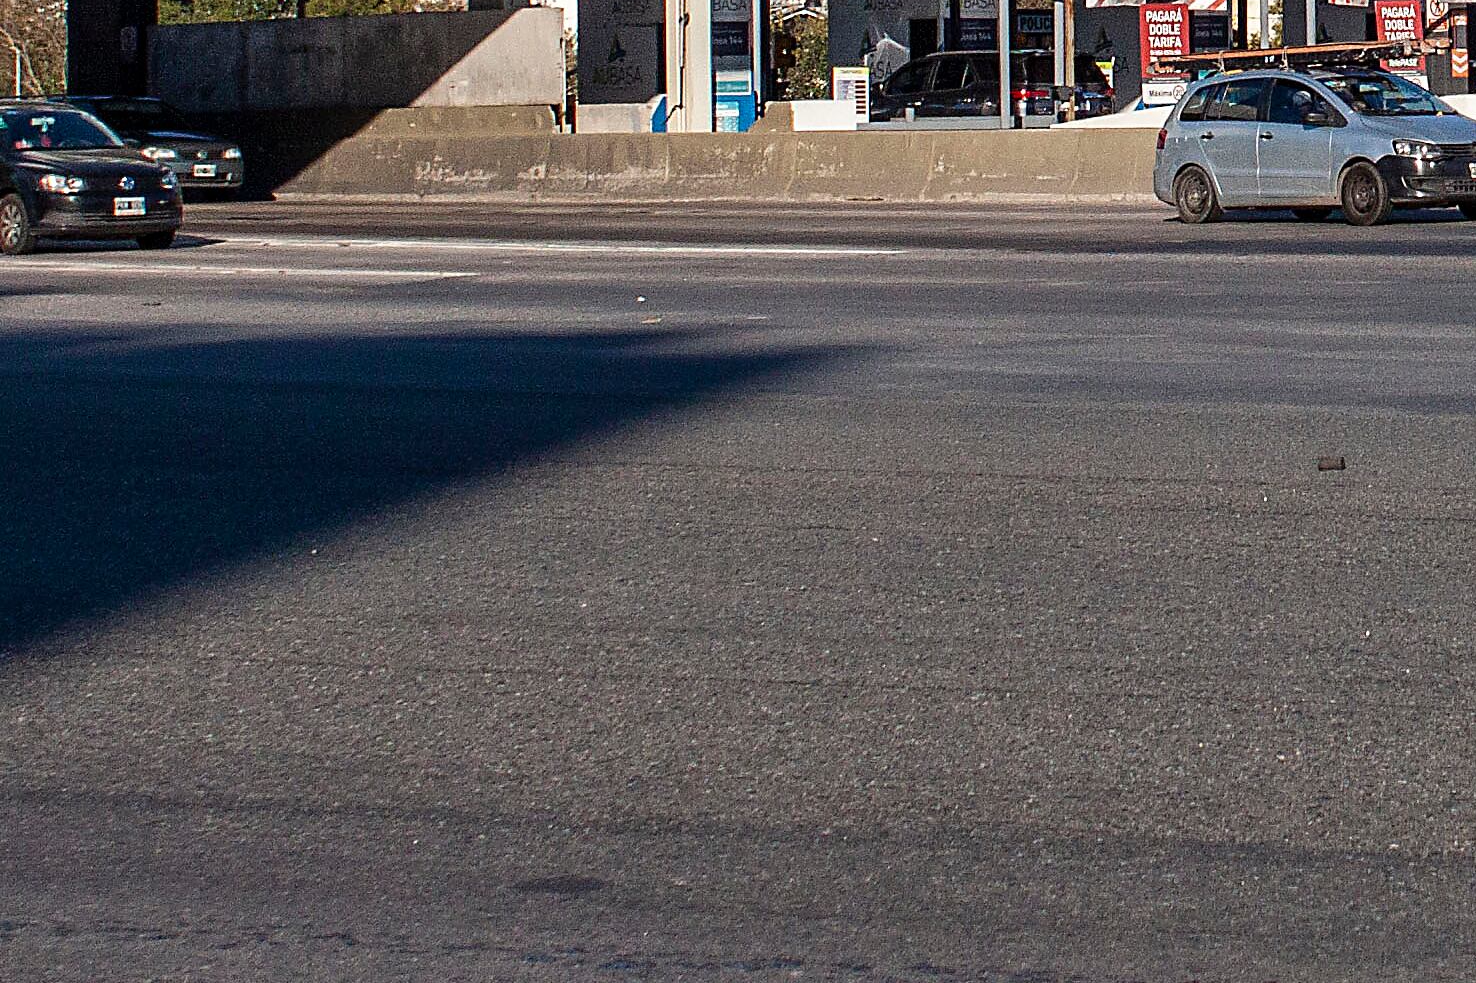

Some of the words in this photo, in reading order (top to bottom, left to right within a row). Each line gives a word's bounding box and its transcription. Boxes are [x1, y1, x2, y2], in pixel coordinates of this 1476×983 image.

[1146, 7, 1183, 23] PAGARÁ
[1381, 4, 1416, 18] PAGARÁ
[1149, 24, 1180, 35] DOBLE
[1384, 19, 1414, 31] DOBLE
[1148, 36, 1182, 48] TARIFA
